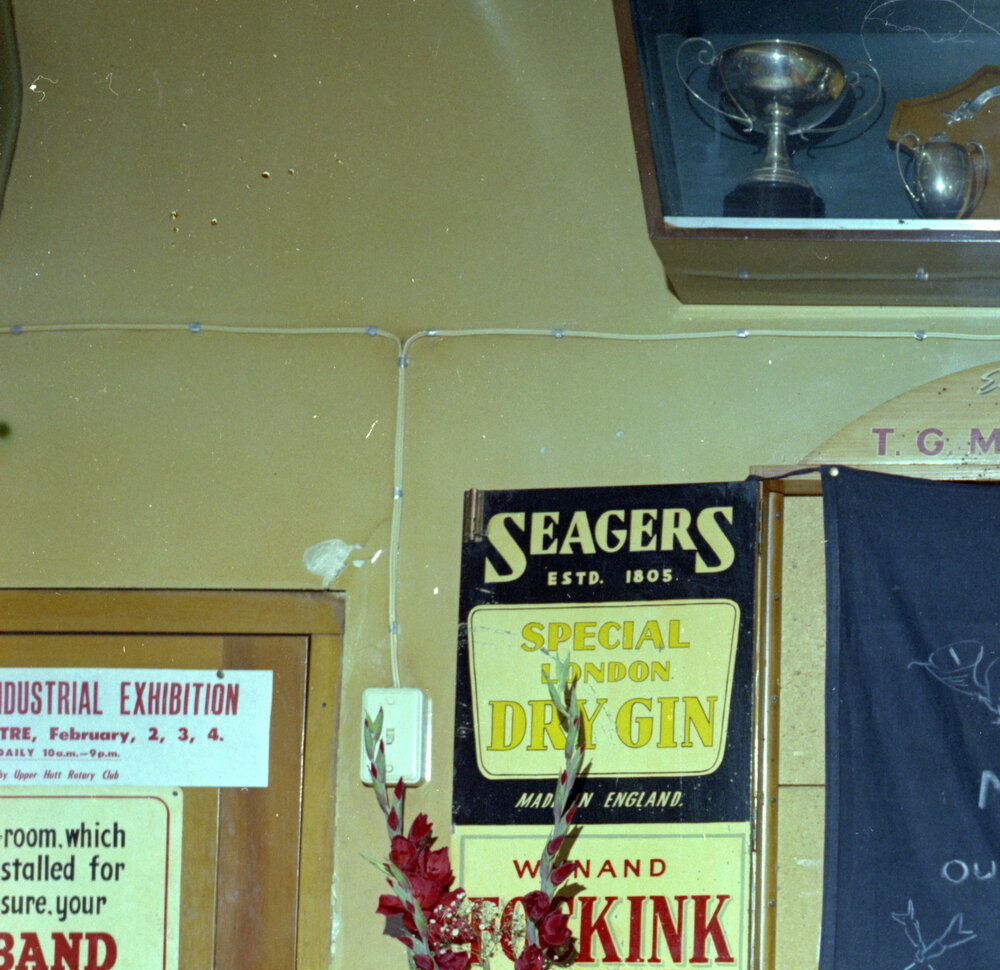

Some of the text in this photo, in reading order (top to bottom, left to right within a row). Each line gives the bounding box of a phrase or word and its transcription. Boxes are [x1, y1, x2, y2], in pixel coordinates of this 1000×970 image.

[872, 427, 900, 456] T.
[917, 427, 953, 456] G.
[484, 506, 736, 583] SEAGERS
[547, 572, 604, 585] ESTD.
[520, 619, 691, 652] SPECIAL
[541, 660, 671, 684] LONDON
[0, 681, 240, 715] DUSTRIAL EXHIBITION
[49, 727, 136, 744] February,
[148, 727, 165, 743] 2,
[178, 727, 195, 743] 3,
[207, 727, 224, 742] 4.
[486, 696, 719, 751] DRY GIN
[14, 769, 38, 780] Upper
[43, 769, 62, 780] Hutt
[67, 769, 96, 781] Rotary
[102, 769, 119, 780] Club
[515, 792, 555, 808] MAD
[604, 791, 683, 808] ENGLAND.
[0, 854, 125, 881] stalled for
[513, 858, 667, 879] WNAND
[56, 895, 107, 922] your
[468, 894, 735, 964] FOKINK
